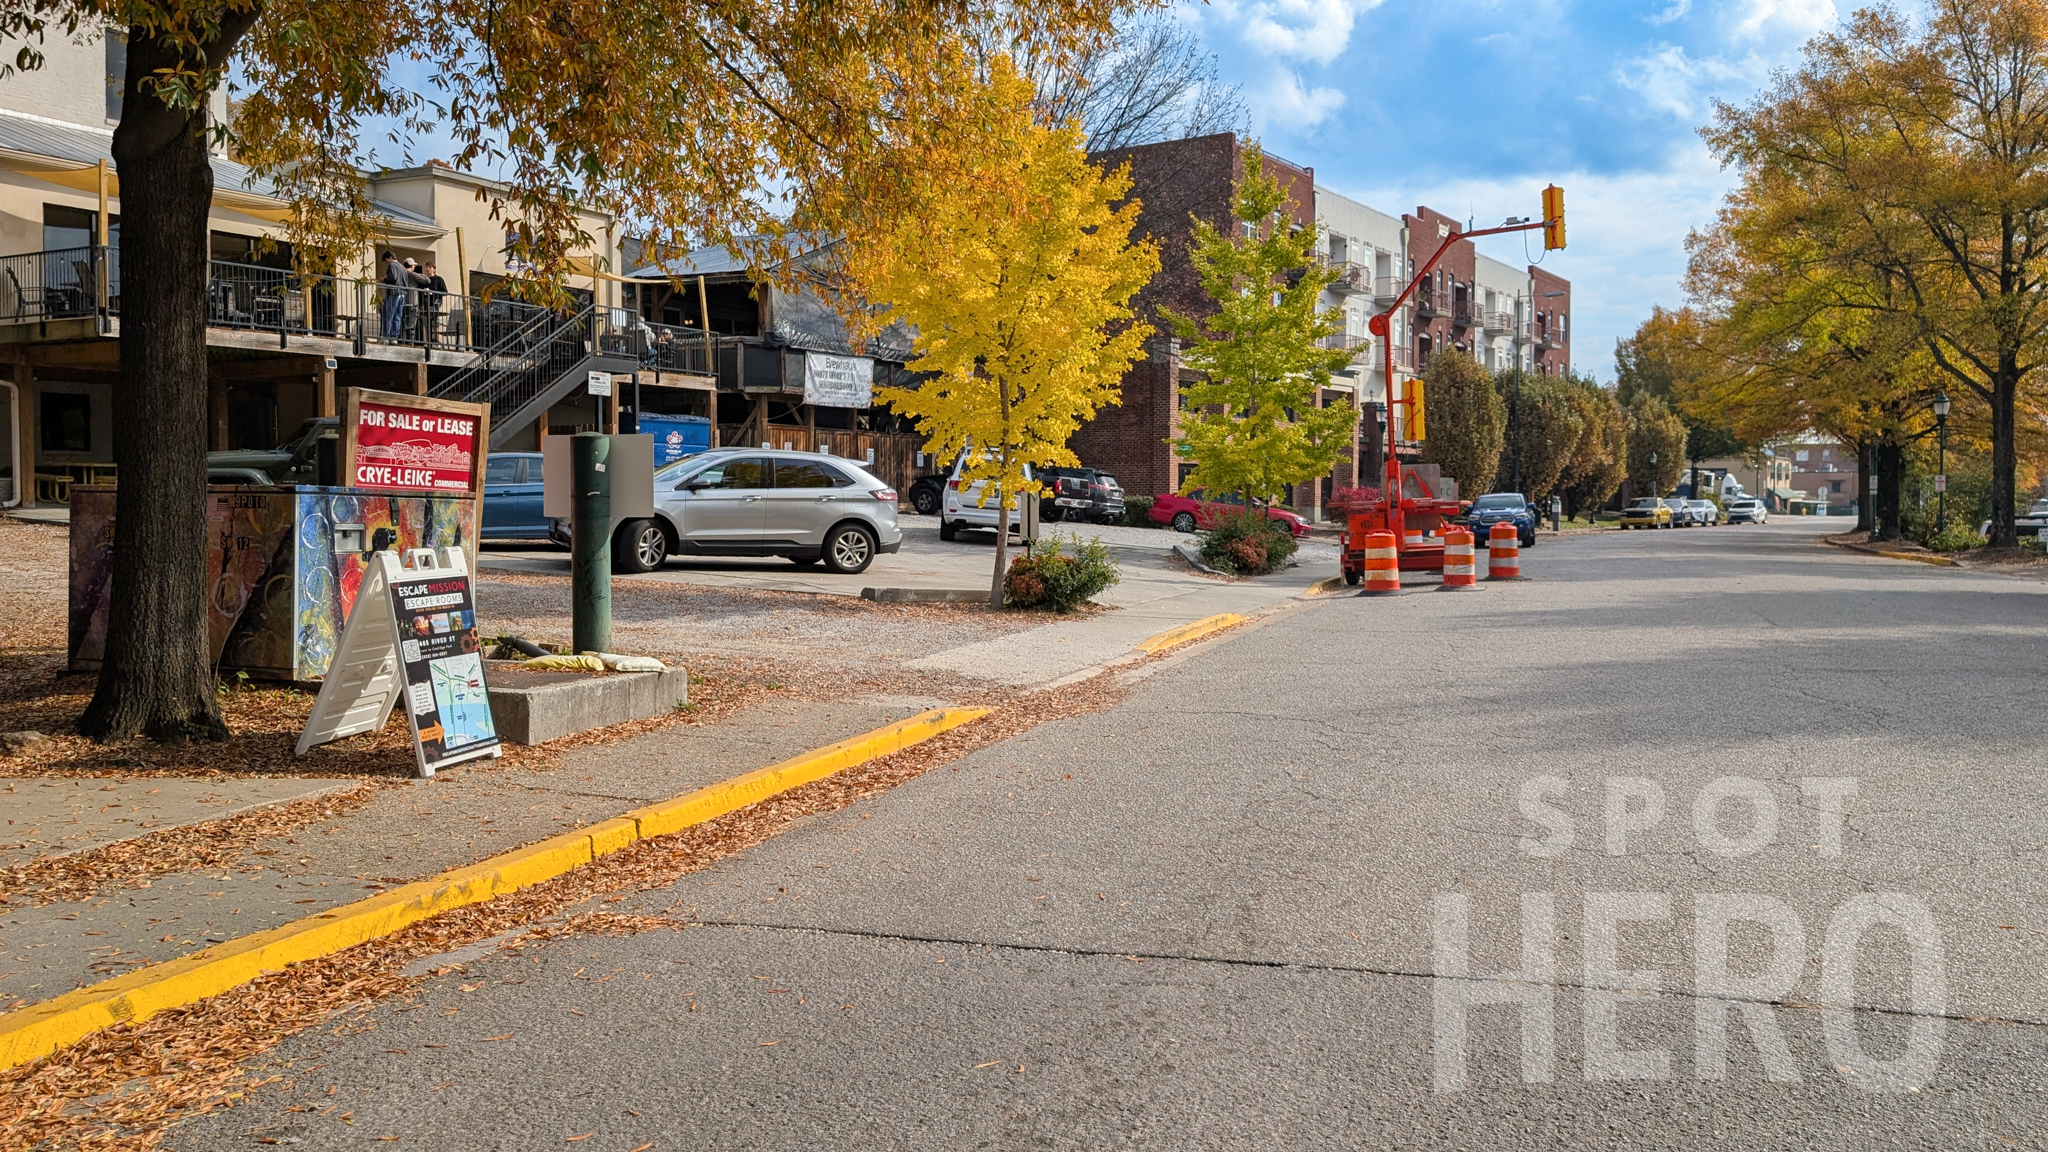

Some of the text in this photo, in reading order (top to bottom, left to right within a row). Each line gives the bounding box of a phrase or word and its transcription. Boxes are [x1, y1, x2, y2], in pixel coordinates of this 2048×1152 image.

[826, 358, 857, 371] Brewhaus
[360, 409, 473, 436] FOR SALE or LEASE
[357, 466, 469, 489] CRYE-LEIKE COMMERCIAL
[229, 496, 266, 508] H9P010
[238, 537, 249, 549] 12
[405, 594, 463, 608] ESCAPE ROOMS
[431, 636, 447, 645] RIVER
